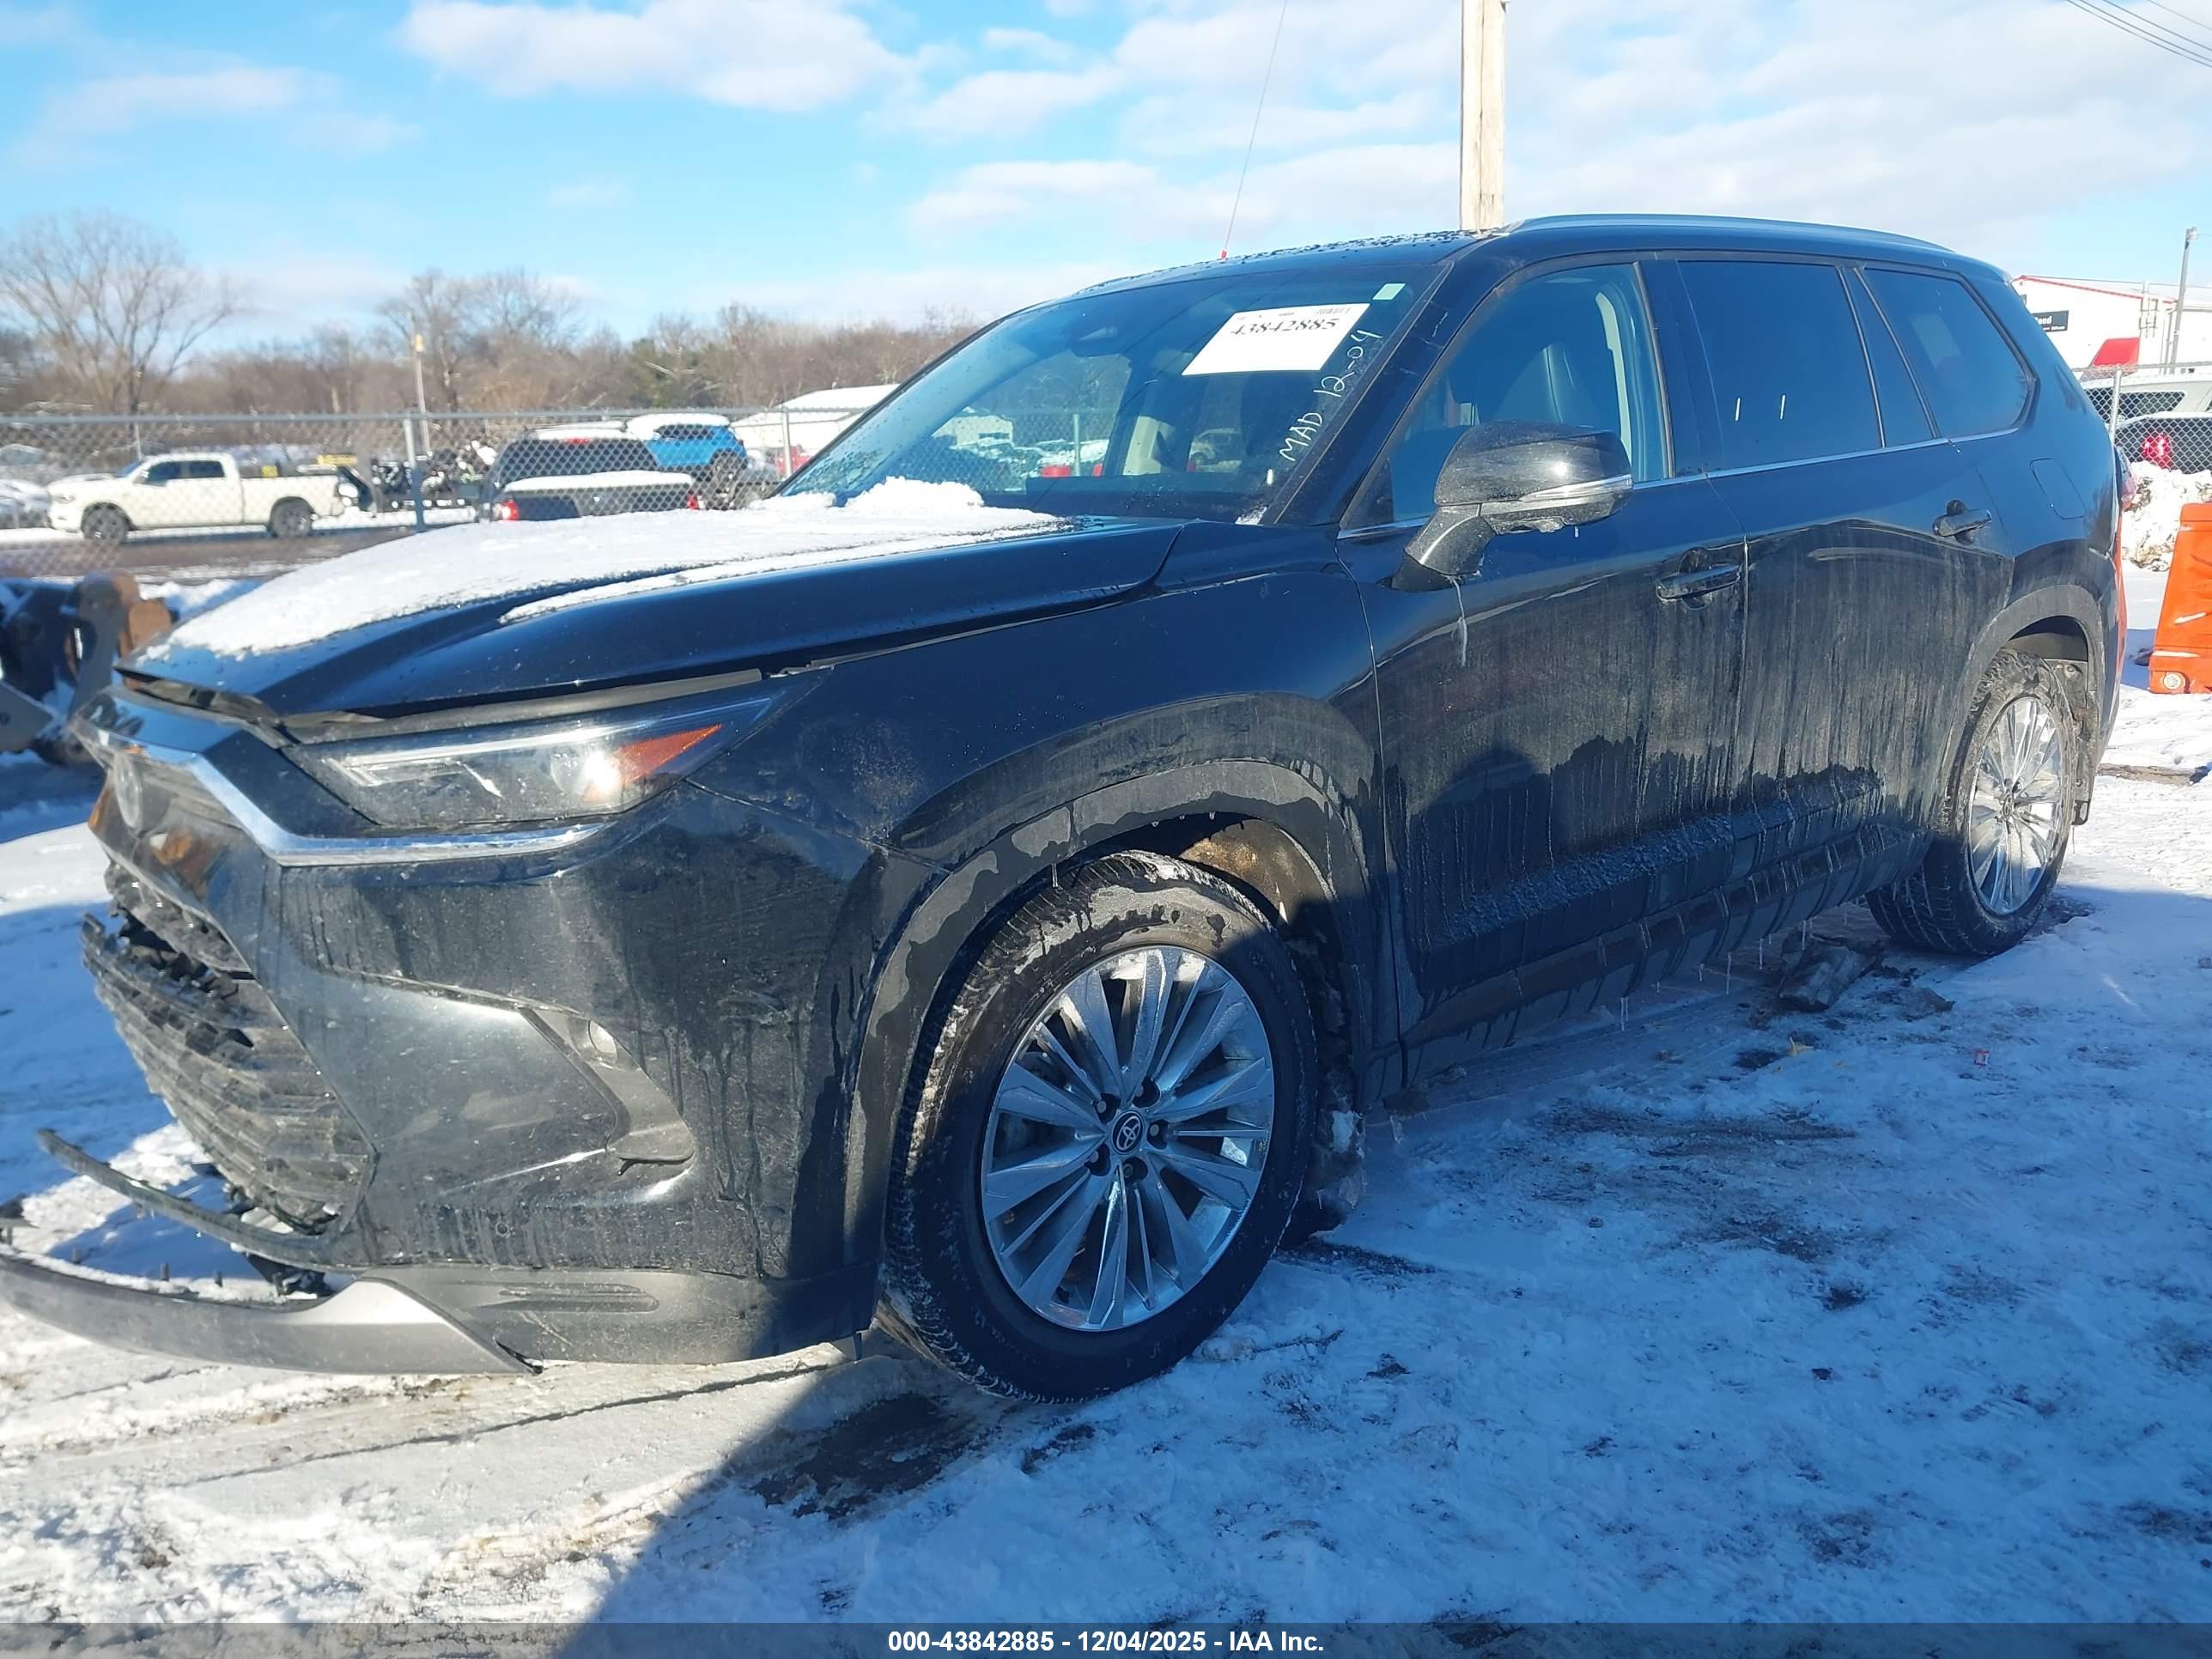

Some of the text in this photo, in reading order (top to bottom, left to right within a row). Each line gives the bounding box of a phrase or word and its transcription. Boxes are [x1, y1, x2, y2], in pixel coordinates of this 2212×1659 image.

[1231, 319, 1340, 335] 43842885
[1279, 330, 1382, 461] MAD 12-04
